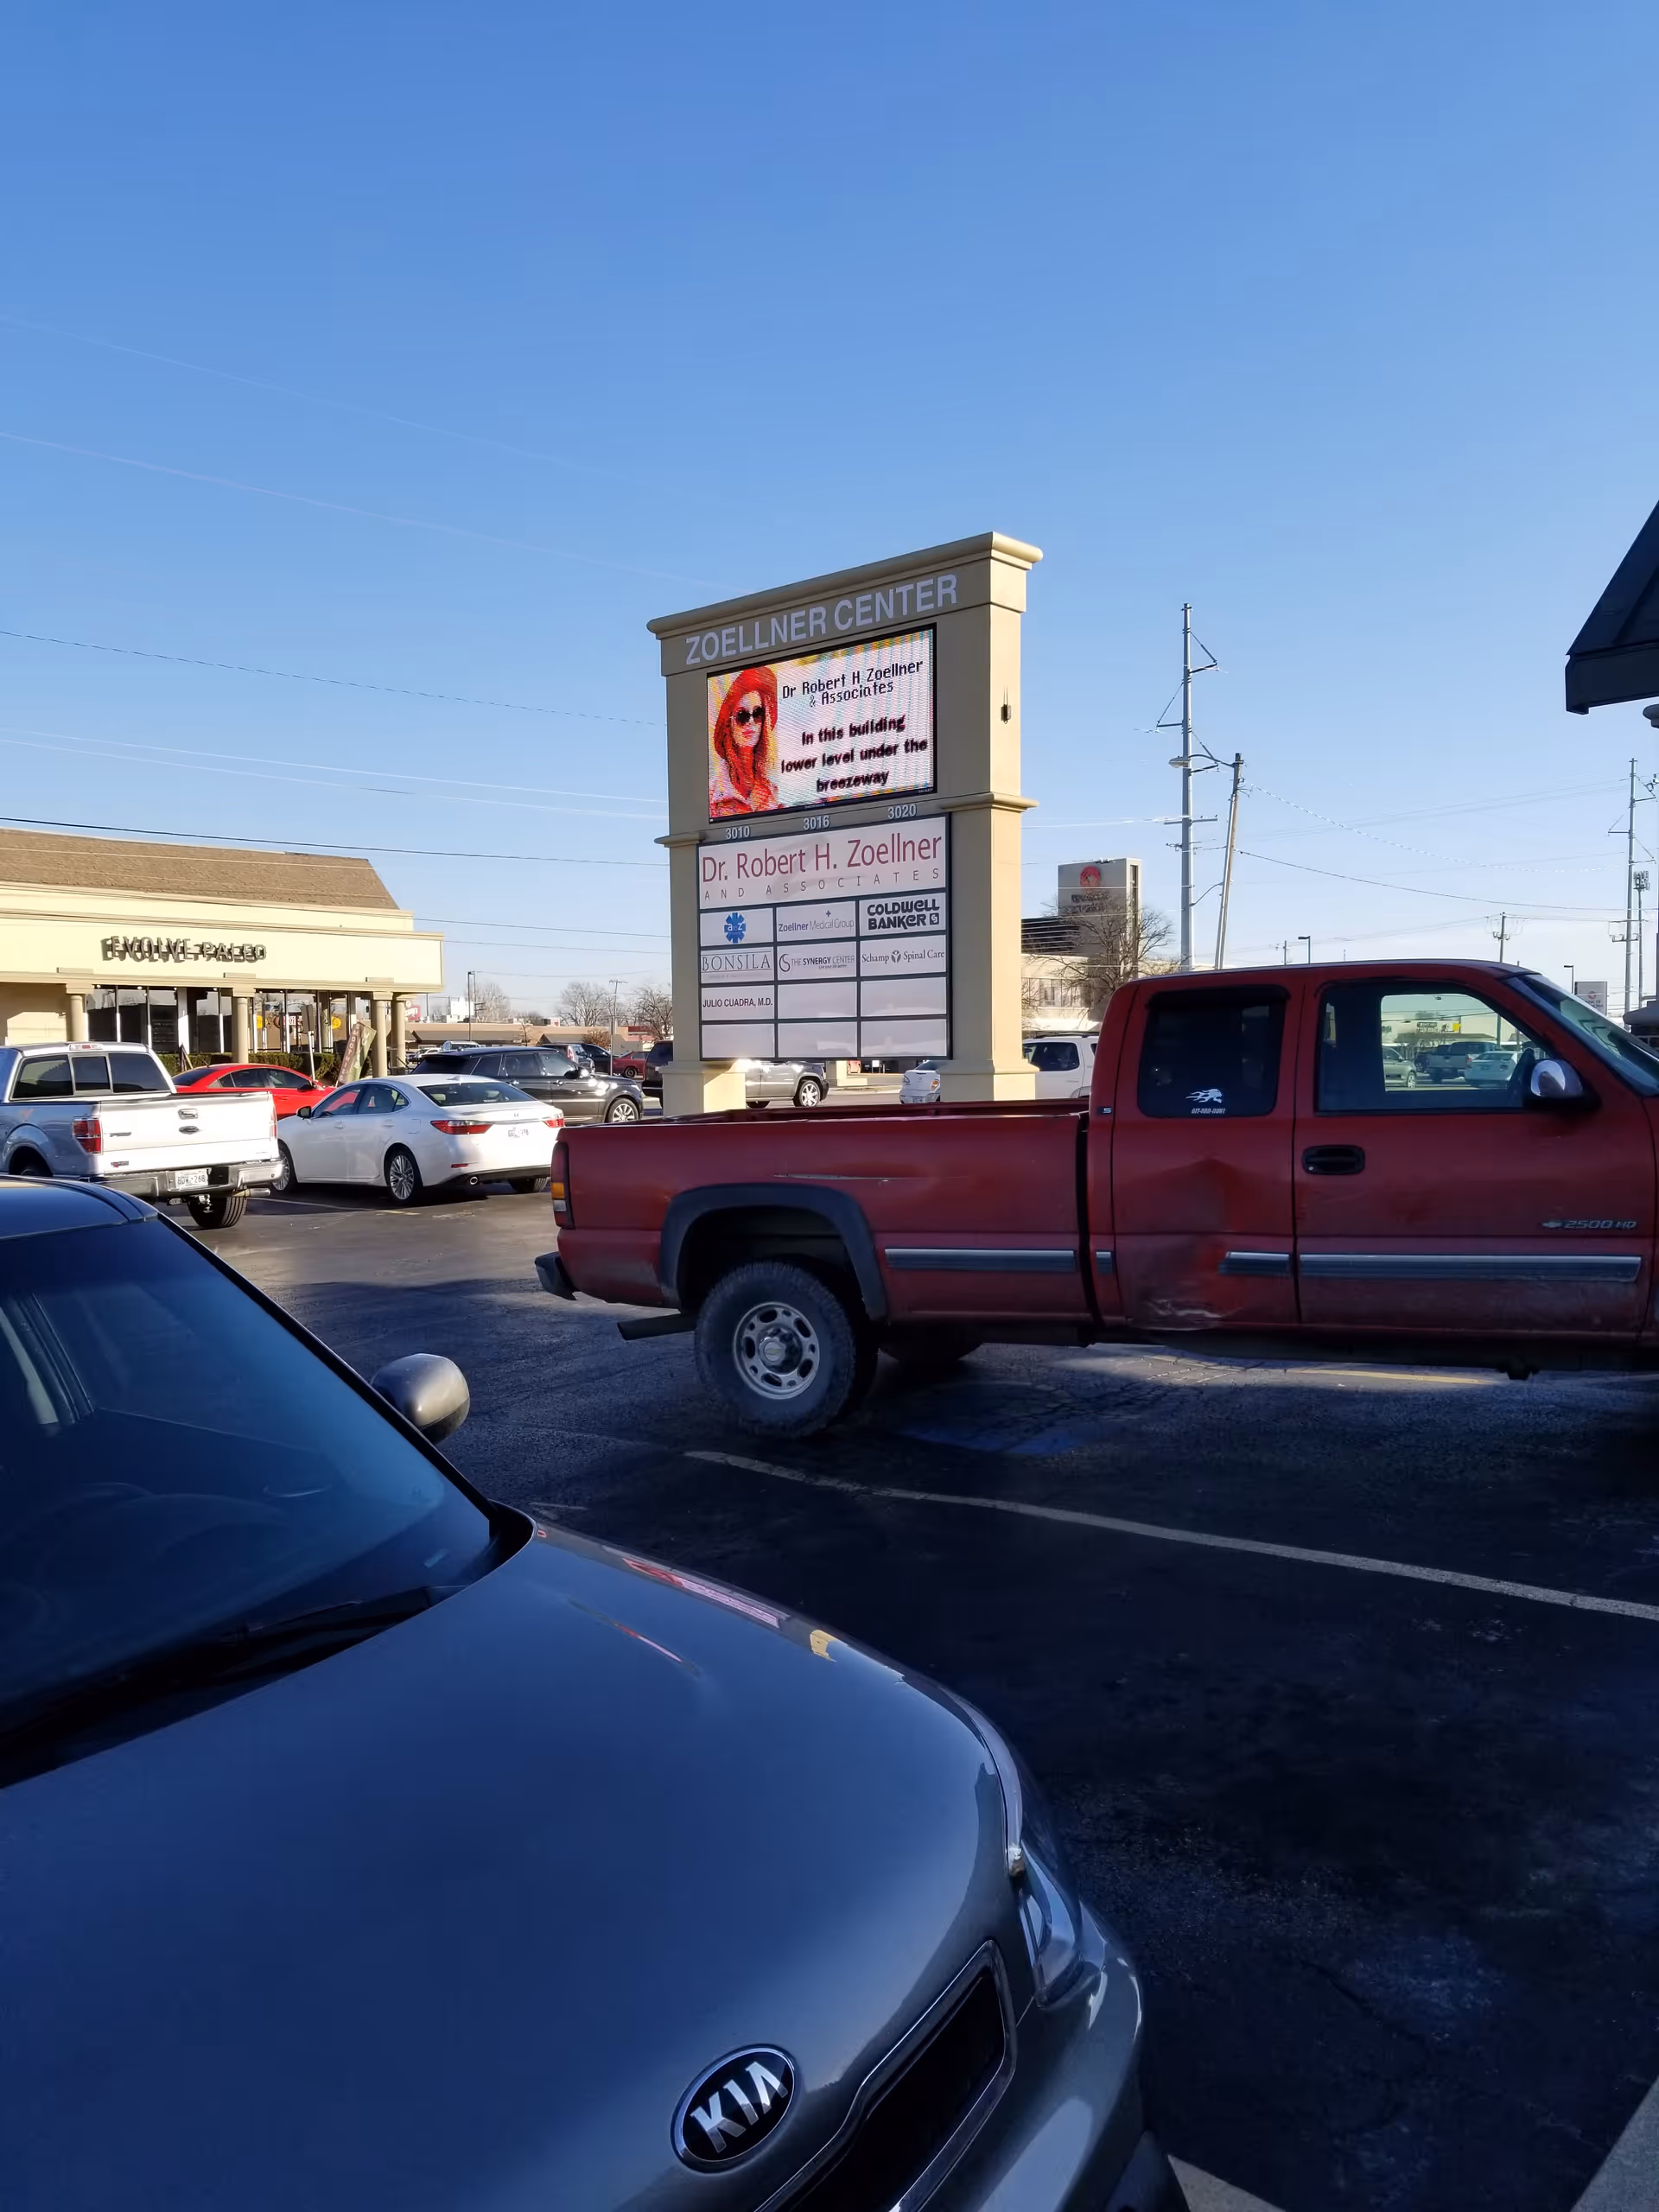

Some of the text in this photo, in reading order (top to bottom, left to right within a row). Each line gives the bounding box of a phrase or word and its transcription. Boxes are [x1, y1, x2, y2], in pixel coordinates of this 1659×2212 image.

[685, 574, 958, 664] ZOELLNER CENTER
[782, 660, 924, 699] Dr Robert H Zoellner
[809, 681, 894, 708] & Associates
[802, 714, 906, 746] In this building
[781, 738, 928, 773] lower level under the
[816, 771, 890, 792] breezeway
[725, 803, 918, 840] 3010 3016 3020
[702, 832, 942, 883] Dr. Robert H. Zoellner
[704, 868, 940, 901] AND ASSOCIATES
[778, 922, 809, 932] Zoellner
[834, 918, 855, 931] Group
[110, 936, 268, 961] EVOLVE PALEO
[791, 955, 855, 966] THE SYNERGY CENTER
[861, 949, 945, 963] Schamp Spinal Care
[702, 954, 771, 971] BONSILA
[723, 998, 756, 1007] CUADRA,
[757, 997, 773, 1006] M.D.
[1565, 1219, 1637, 1229] 2500 HD
[690, 2062, 788, 2153] KIA
